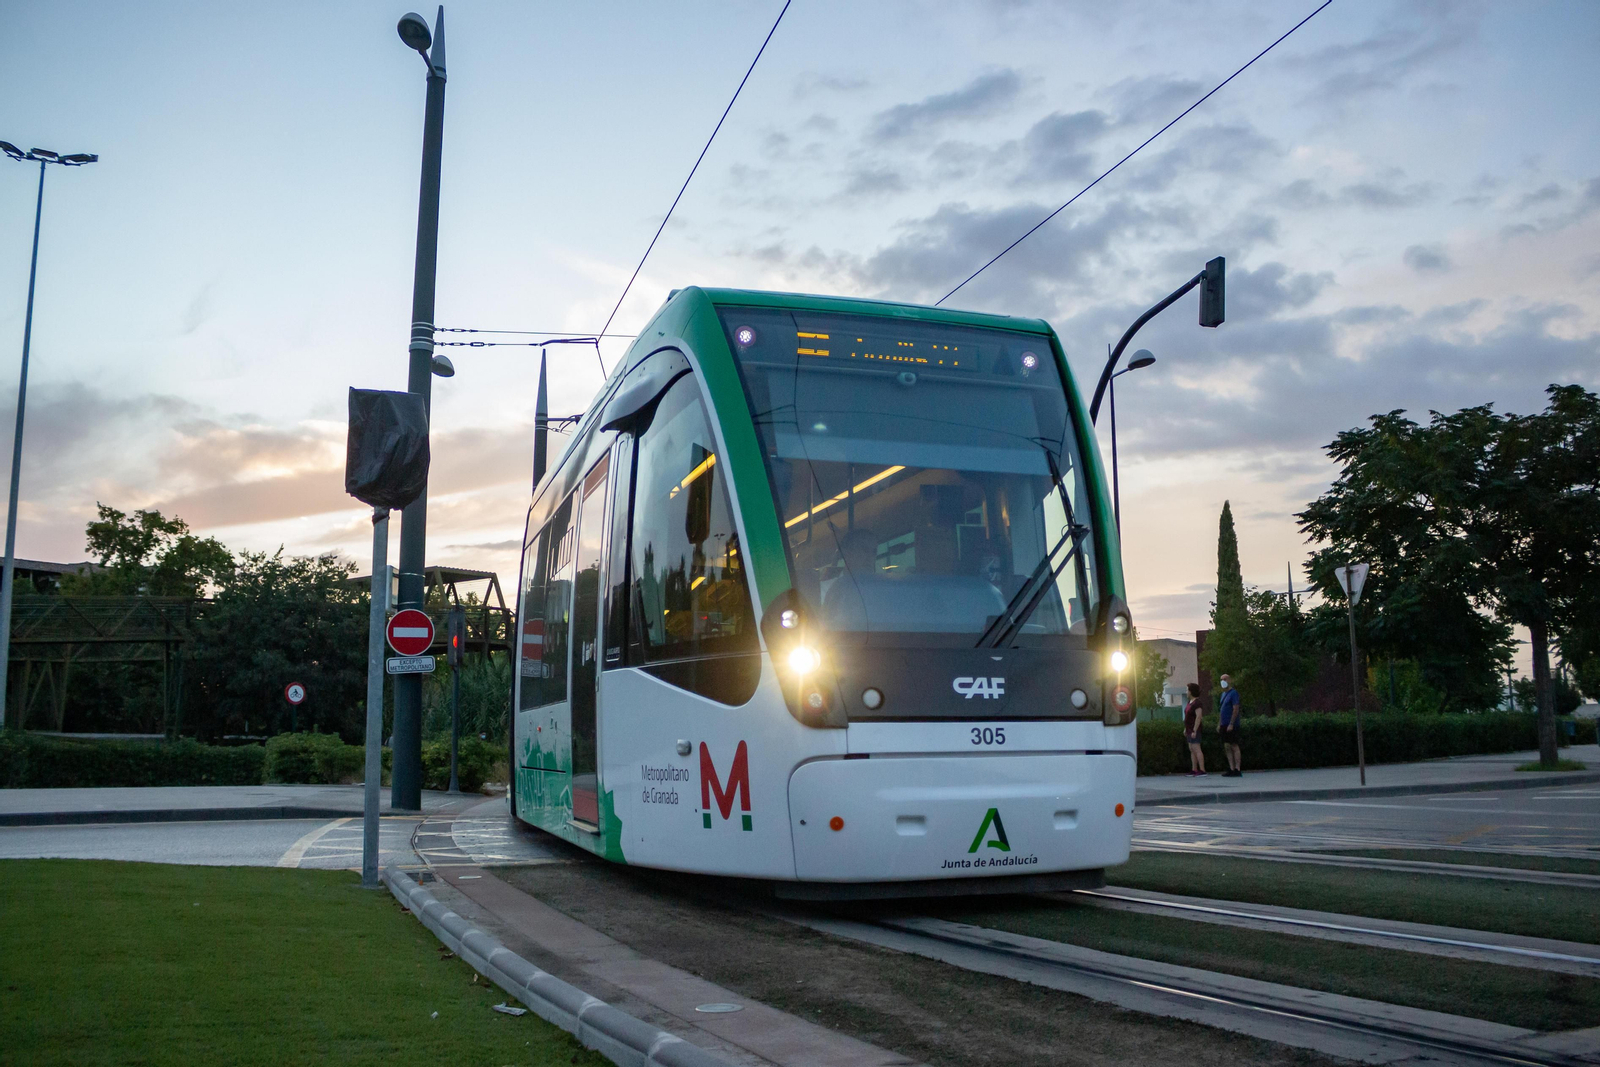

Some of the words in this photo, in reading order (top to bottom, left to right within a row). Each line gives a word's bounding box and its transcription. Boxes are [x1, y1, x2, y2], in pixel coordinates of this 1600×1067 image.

[953, 677, 1005, 699] CAF
[971, 727, 1006, 746] 305
[641, 764, 690, 785] Metropolitano
[642, 786, 650, 804] de
[650, 787, 679, 805] Granada
[941, 860, 971, 869] Junta
[973, 858, 987, 868] de
[988, 854, 1038, 867] Andalucía
